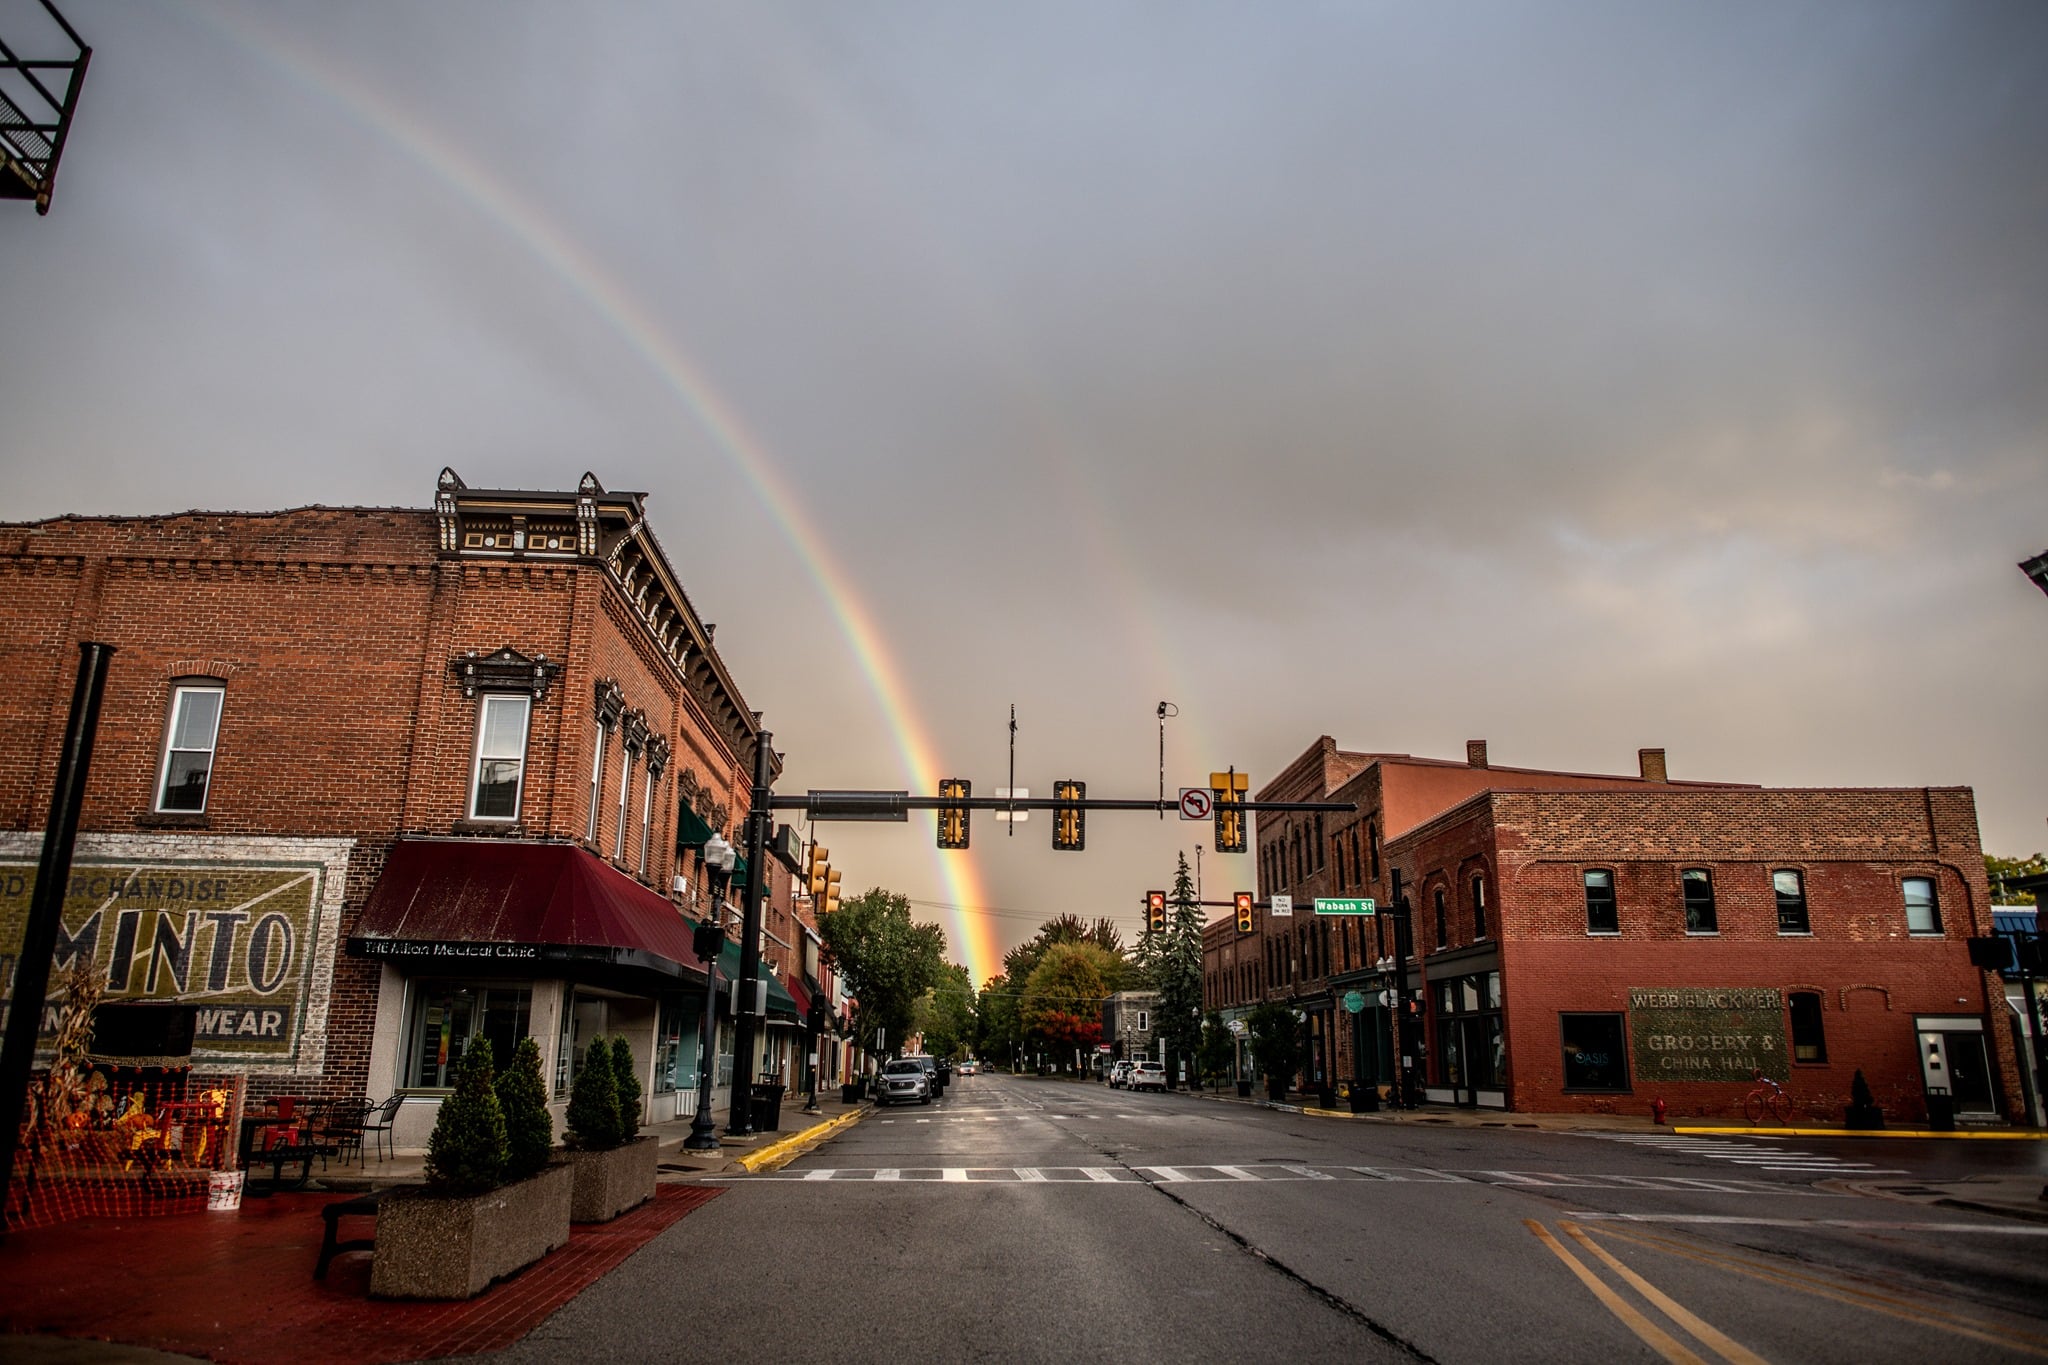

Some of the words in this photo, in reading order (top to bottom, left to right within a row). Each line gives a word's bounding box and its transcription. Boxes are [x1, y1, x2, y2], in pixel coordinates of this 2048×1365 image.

[0, 875, 26, 897] D
[70, 876, 227, 901] RCHANDISE
[1317, 902, 1356, 910] Wabash
[1361, 902, 1373, 910] St
[365, 941, 389, 954] THE
[390, 942, 429, 955] Milan
[433, 944, 492, 957] Medical
[496, 945, 536, 958] Clinic
[195, 1010, 282, 1036] WEAR
[1649, 1035, 1752, 1051] GROCERY
[1762, 1035, 1774, 1051] &
[1575, 1052, 1609, 1064] OASIS
[1661, 1057, 1711, 1070] CHINA
